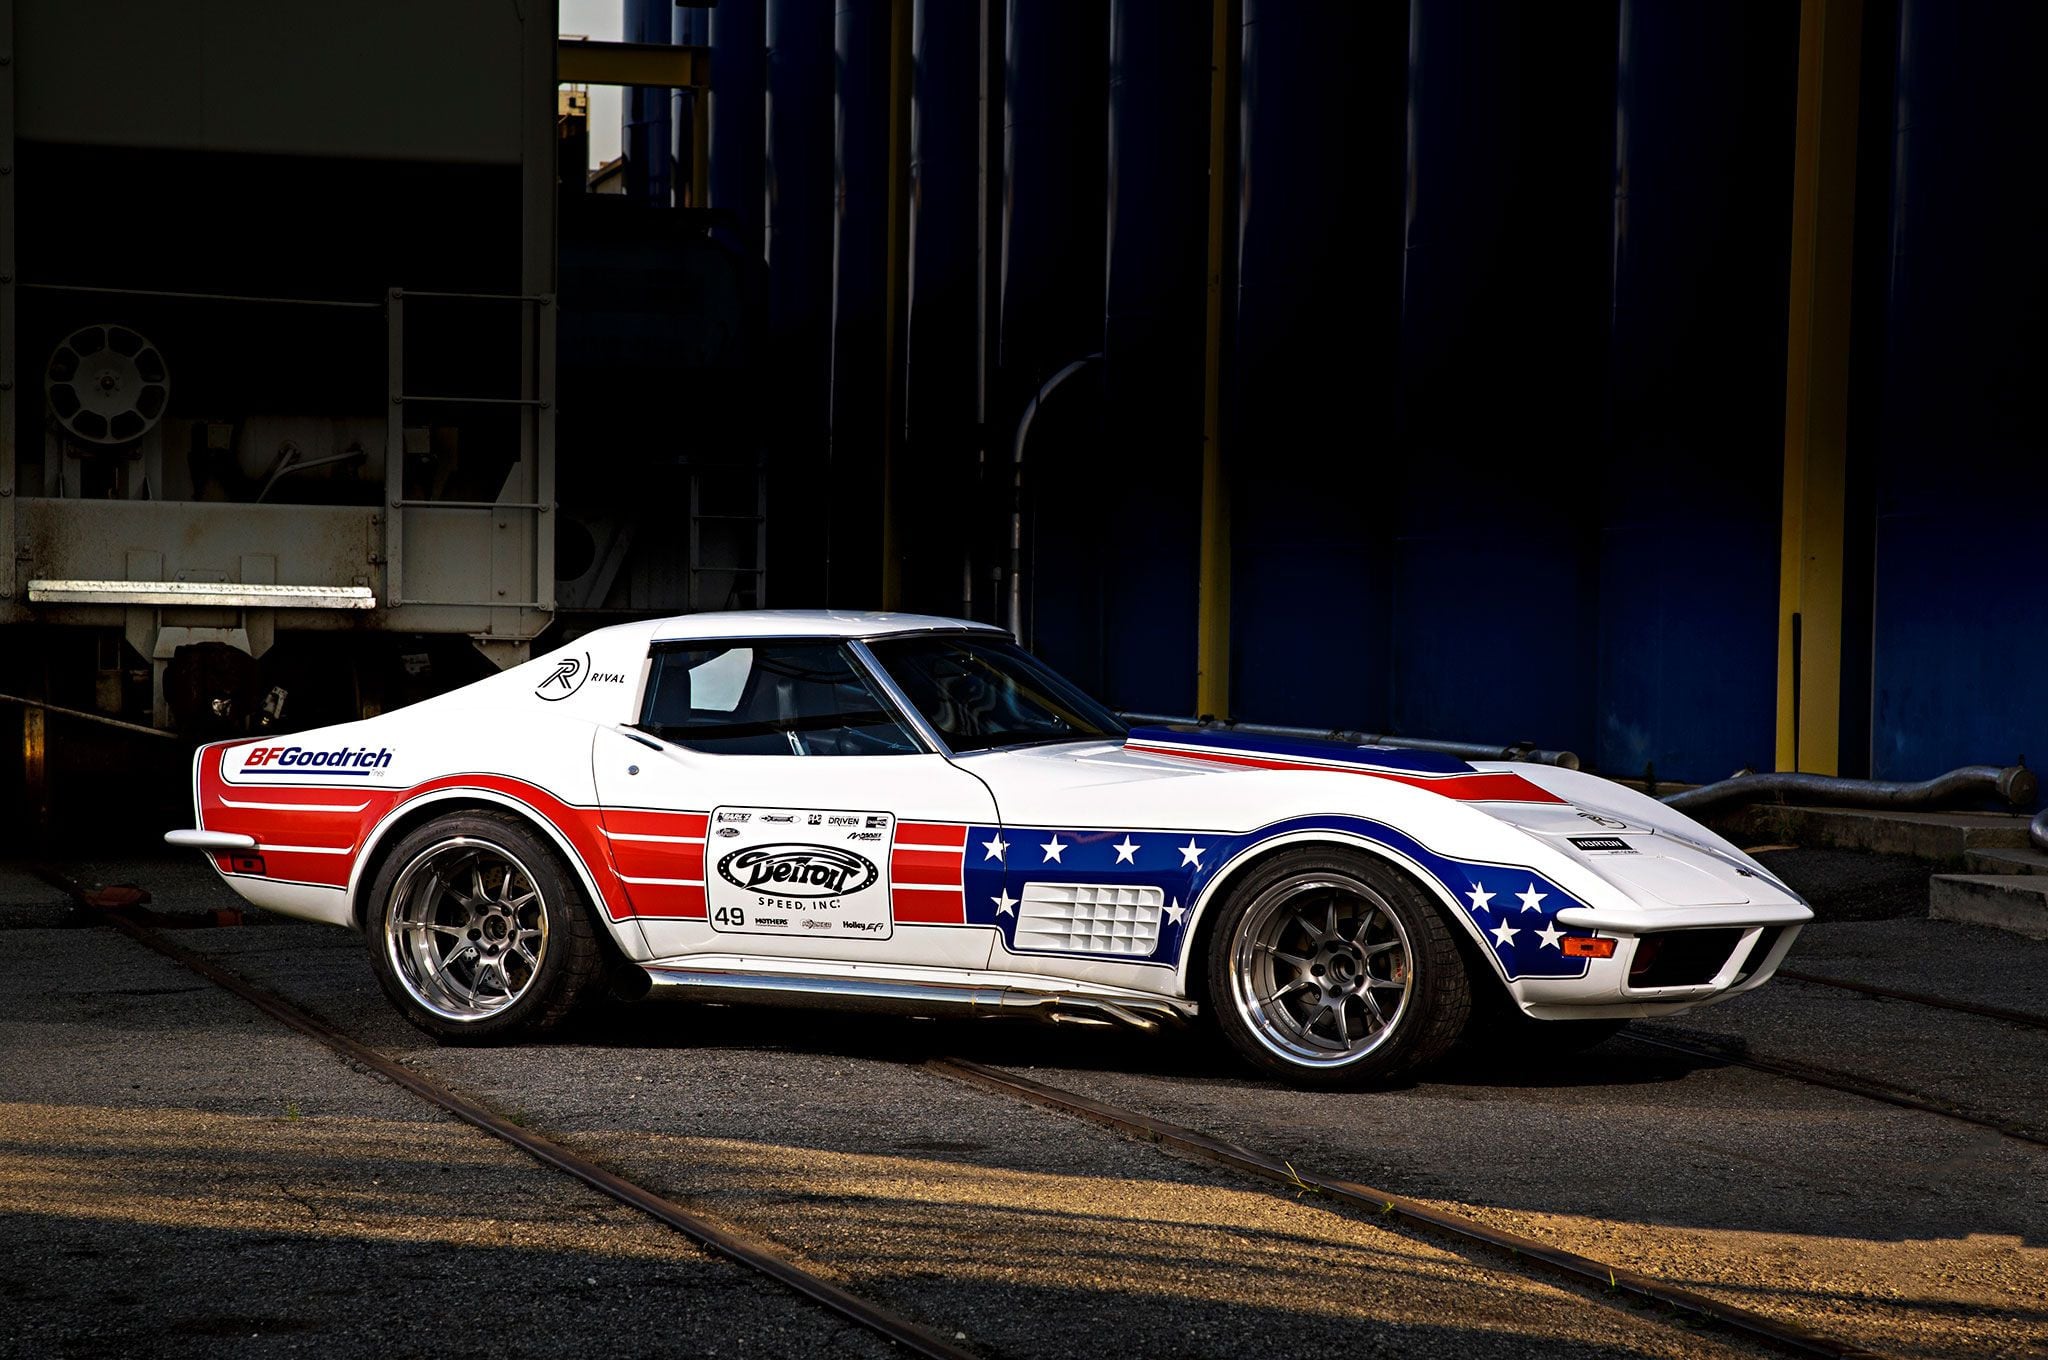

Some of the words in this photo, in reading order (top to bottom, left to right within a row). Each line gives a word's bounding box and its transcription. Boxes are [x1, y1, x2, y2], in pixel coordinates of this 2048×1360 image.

[591, 673, 625, 684] RIVAL
[244, 746, 393, 768] BFGoodrich
[828, 816, 860, 827] DRIVEN
[1576, 840, 1624, 848] NORTON
[758, 897, 806, 911] SPEED,
[715, 907, 745, 926] 49
[755, 917, 788, 925] MOTHERS
[842, 920, 866, 931] Holley
